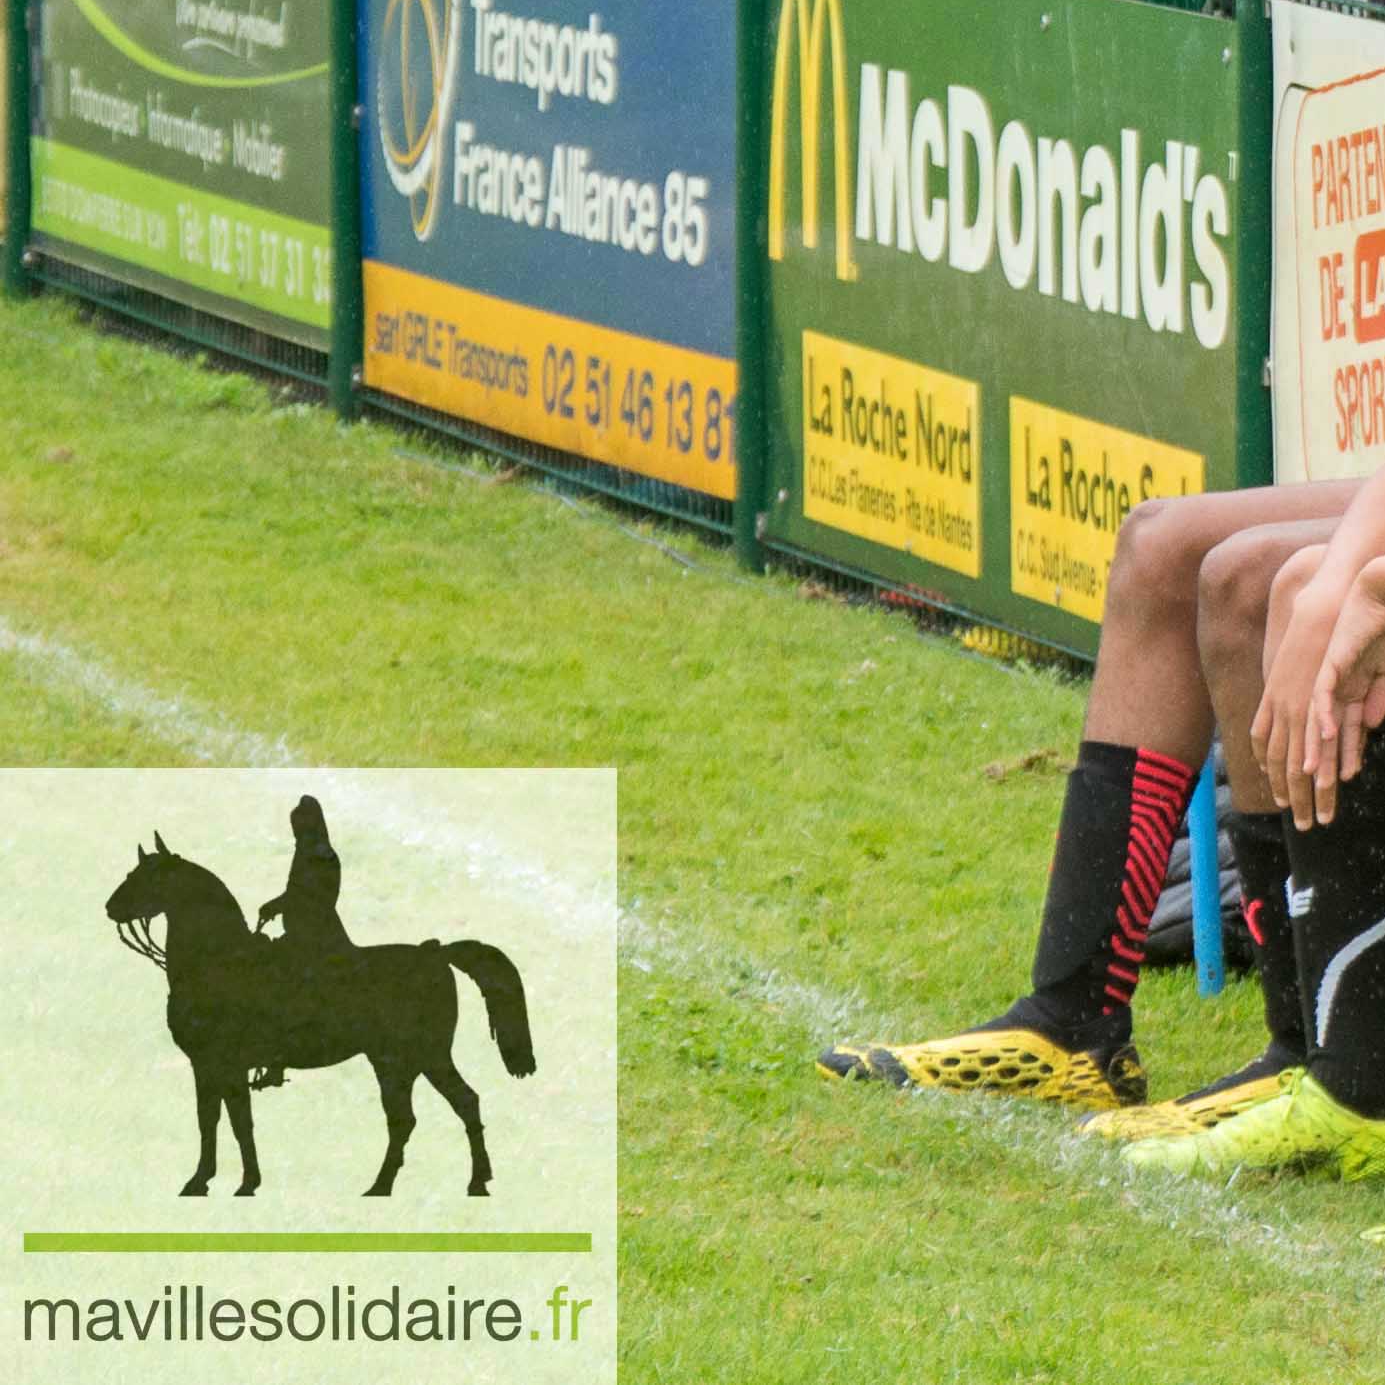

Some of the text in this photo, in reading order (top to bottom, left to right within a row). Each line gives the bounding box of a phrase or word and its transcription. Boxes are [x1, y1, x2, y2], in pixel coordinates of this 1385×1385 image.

[232, 118, 285, 181] Mobilier
[453, 121, 709, 267] France Alliance 85
[855, 62, 1233, 349] McDonald's
[208, 213, 230, 275] 02
[1319, 252, 1346, 342] DE
[448, 323, 529, 399] Transports
[541, 343, 575, 420] 02
[584, 356, 611, 430] 51
[619, 368, 654, 443] 46
[664, 378, 693, 454] 13
[809, 355, 972, 483] La Roche Nord
[1025, 426, 1052, 511] La
[1060, 438, 1130, 535] Roche
